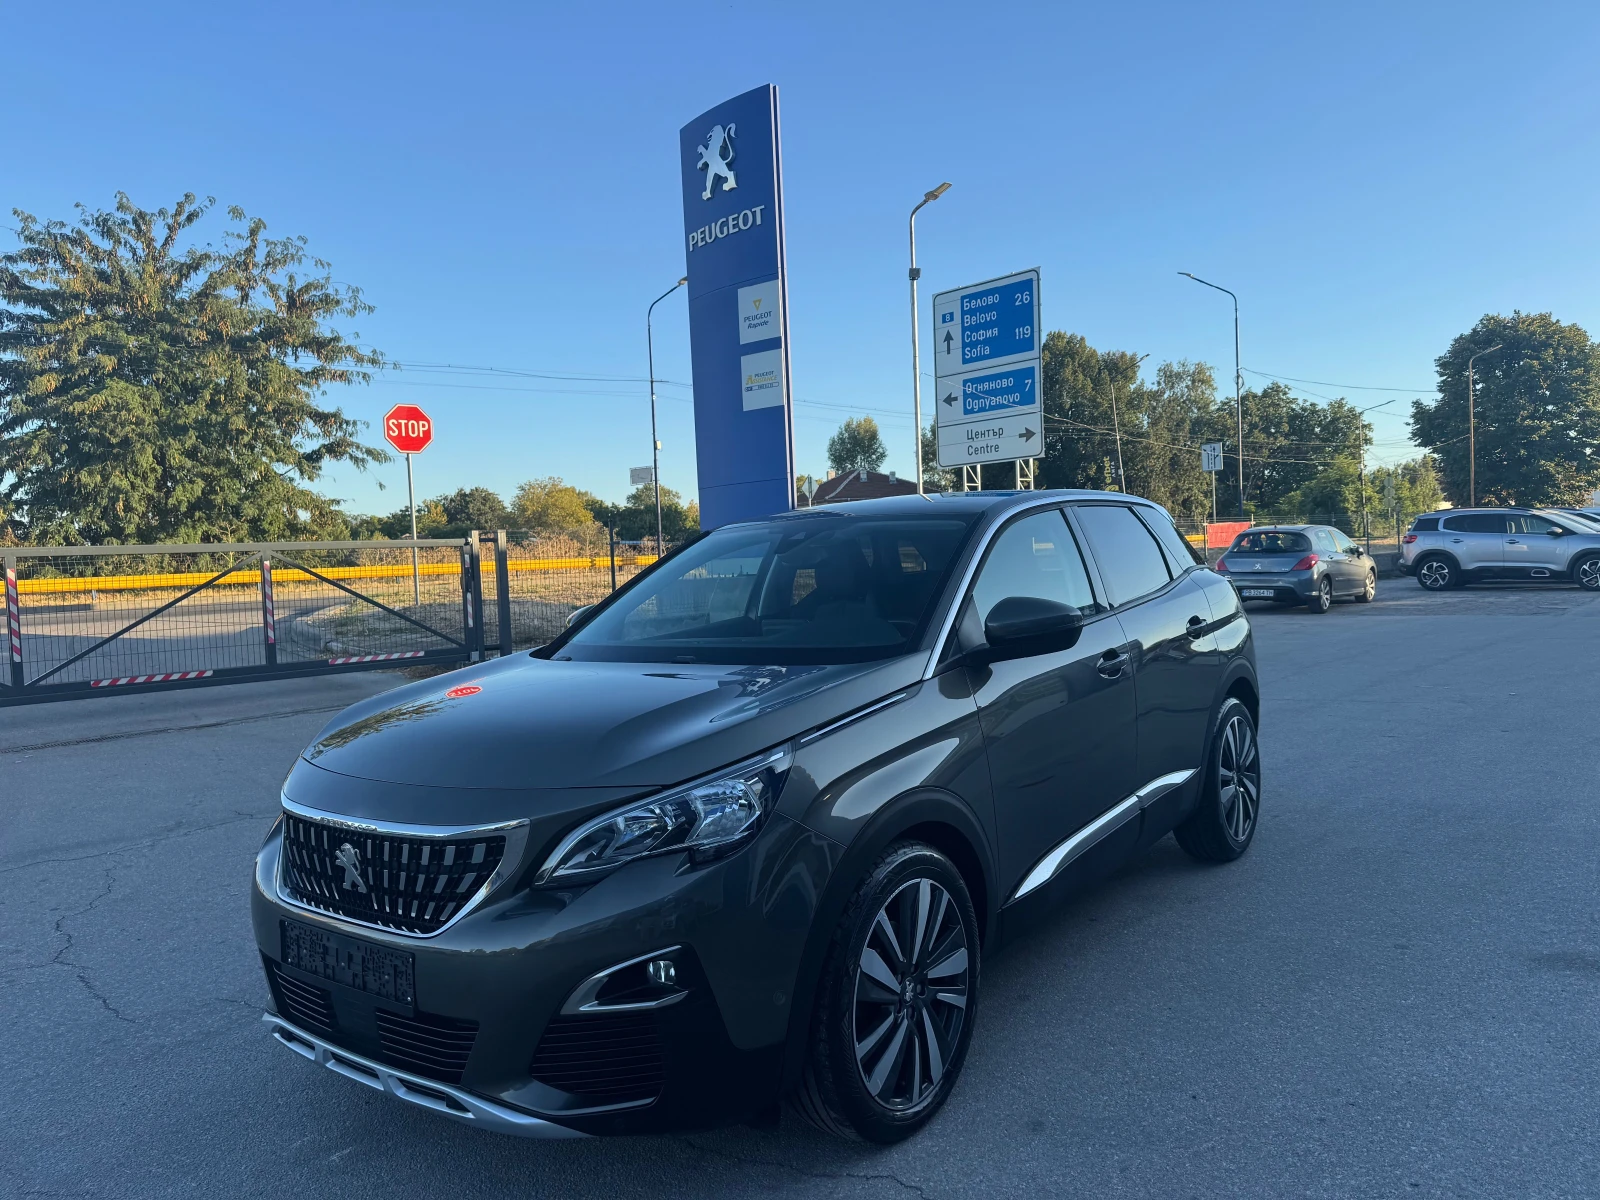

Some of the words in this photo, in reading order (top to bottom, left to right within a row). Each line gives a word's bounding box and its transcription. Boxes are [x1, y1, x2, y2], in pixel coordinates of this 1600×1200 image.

[688, 204, 765, 252] PEUGEOT
[963, 294, 1000, 311] Белово
[1014, 291, 1031, 306] 26
[743, 310, 773, 323] PEUGEOT
[945, 314, 951, 322] 8
[964, 311, 997, 327] Belovo
[747, 320, 769, 329] Rapide
[964, 327, 999, 343] София
[1015, 325, 1031, 340] 119
[964, 344, 990, 359] Sofia
[754, 370, 775, 378] PEUGEOT
[965, 377, 1014, 394] Огняново
[1024, 379, 1032, 392] 7
[966, 393, 1020, 412] Ognyanovo
[388, 418, 429, 438] STOP
[966, 427, 1004, 441] Център
[967, 443, 1000, 456] Centre
